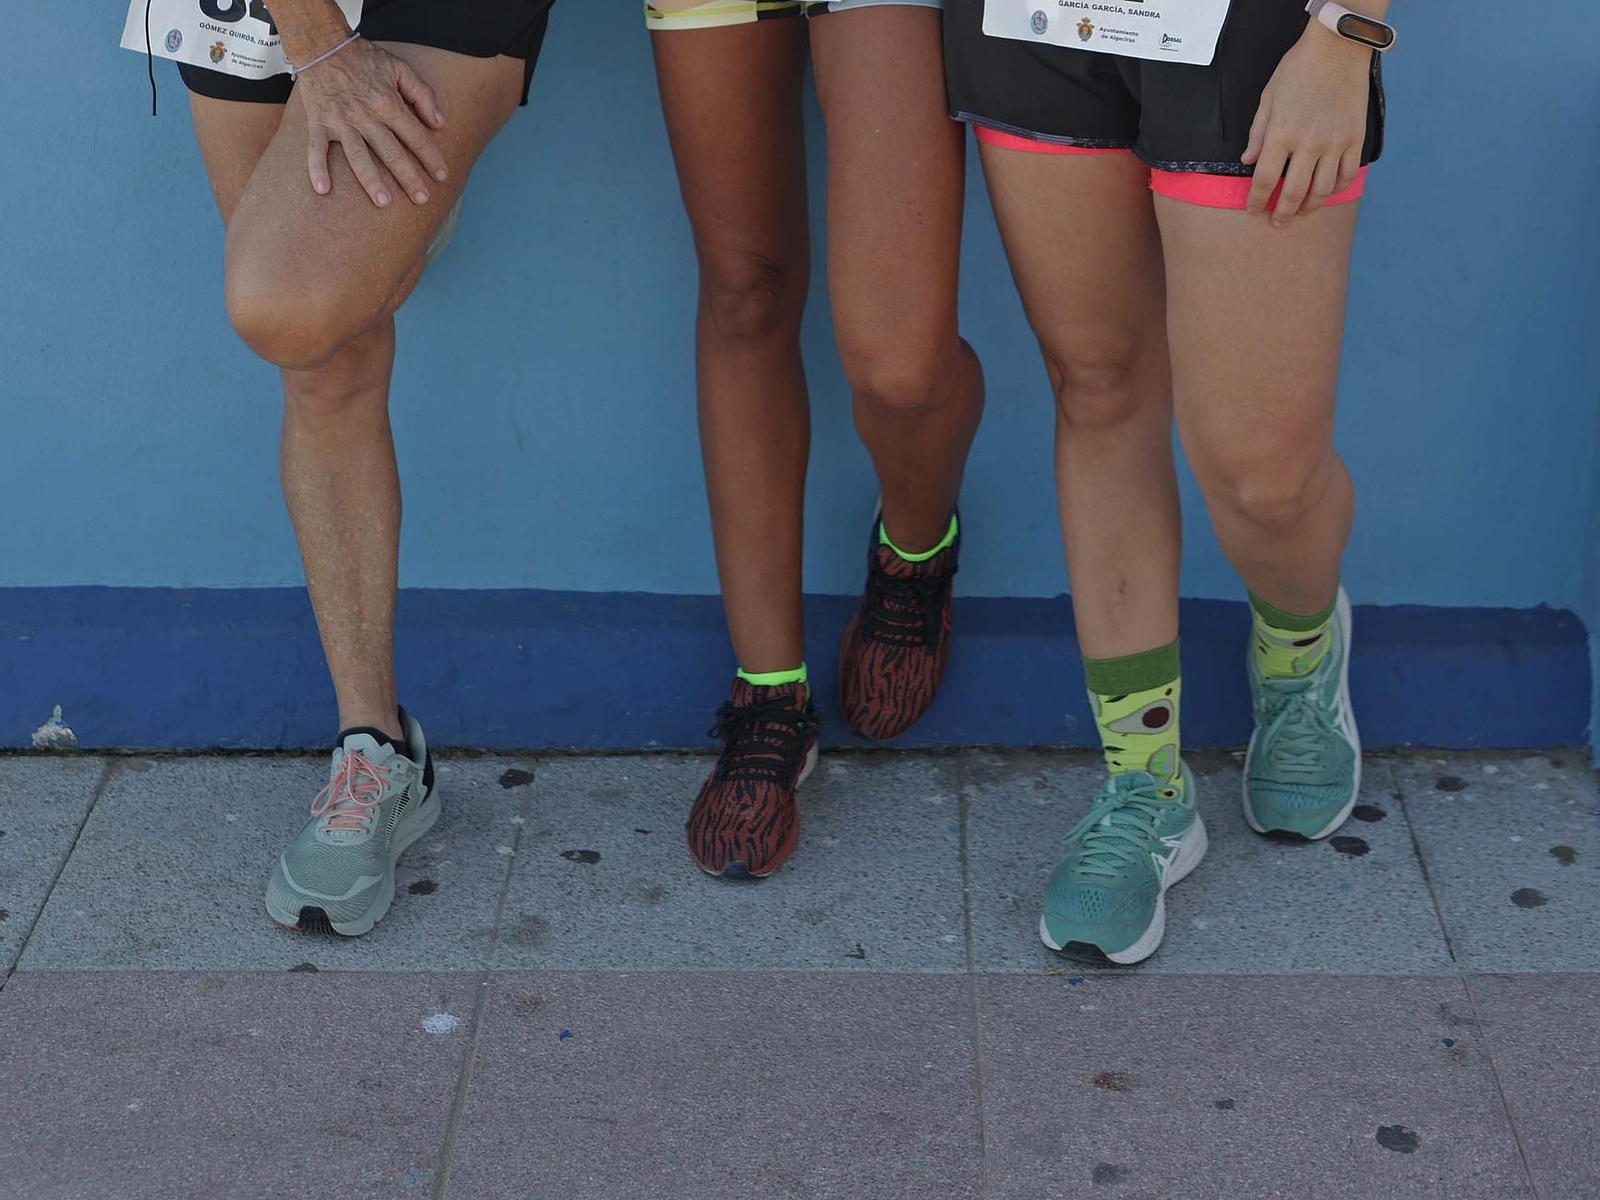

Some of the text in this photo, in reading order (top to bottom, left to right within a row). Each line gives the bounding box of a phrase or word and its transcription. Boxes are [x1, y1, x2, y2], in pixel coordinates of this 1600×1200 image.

[1058, 0, 1161, 19] GARCÍA GARCÍA, SANDRA
[1099, 26, 1139, 37] Ayuntamiento
[1110, 34, 1136, 44] Algeciras
